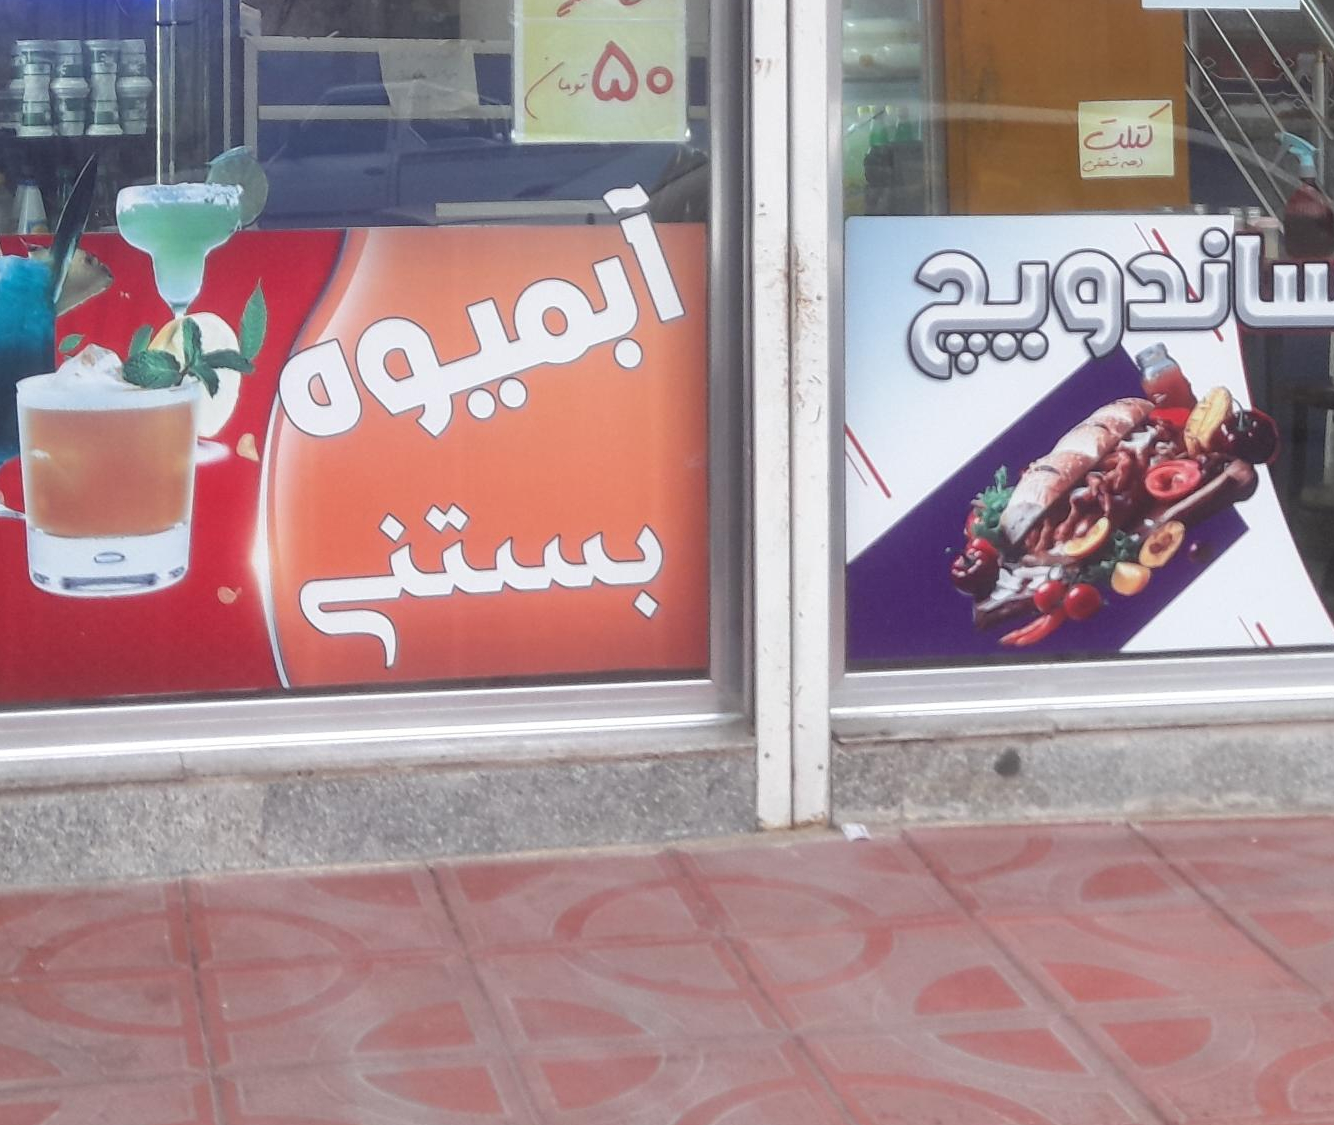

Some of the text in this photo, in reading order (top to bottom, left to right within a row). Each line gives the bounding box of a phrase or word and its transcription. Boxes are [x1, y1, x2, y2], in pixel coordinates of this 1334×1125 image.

[523, 55, 589, 120] تومان
[591, 39, 674, 102] ۵۰
[277, 183, 686, 438] آبمیوه
[298, 503, 664, 668] بستنی
